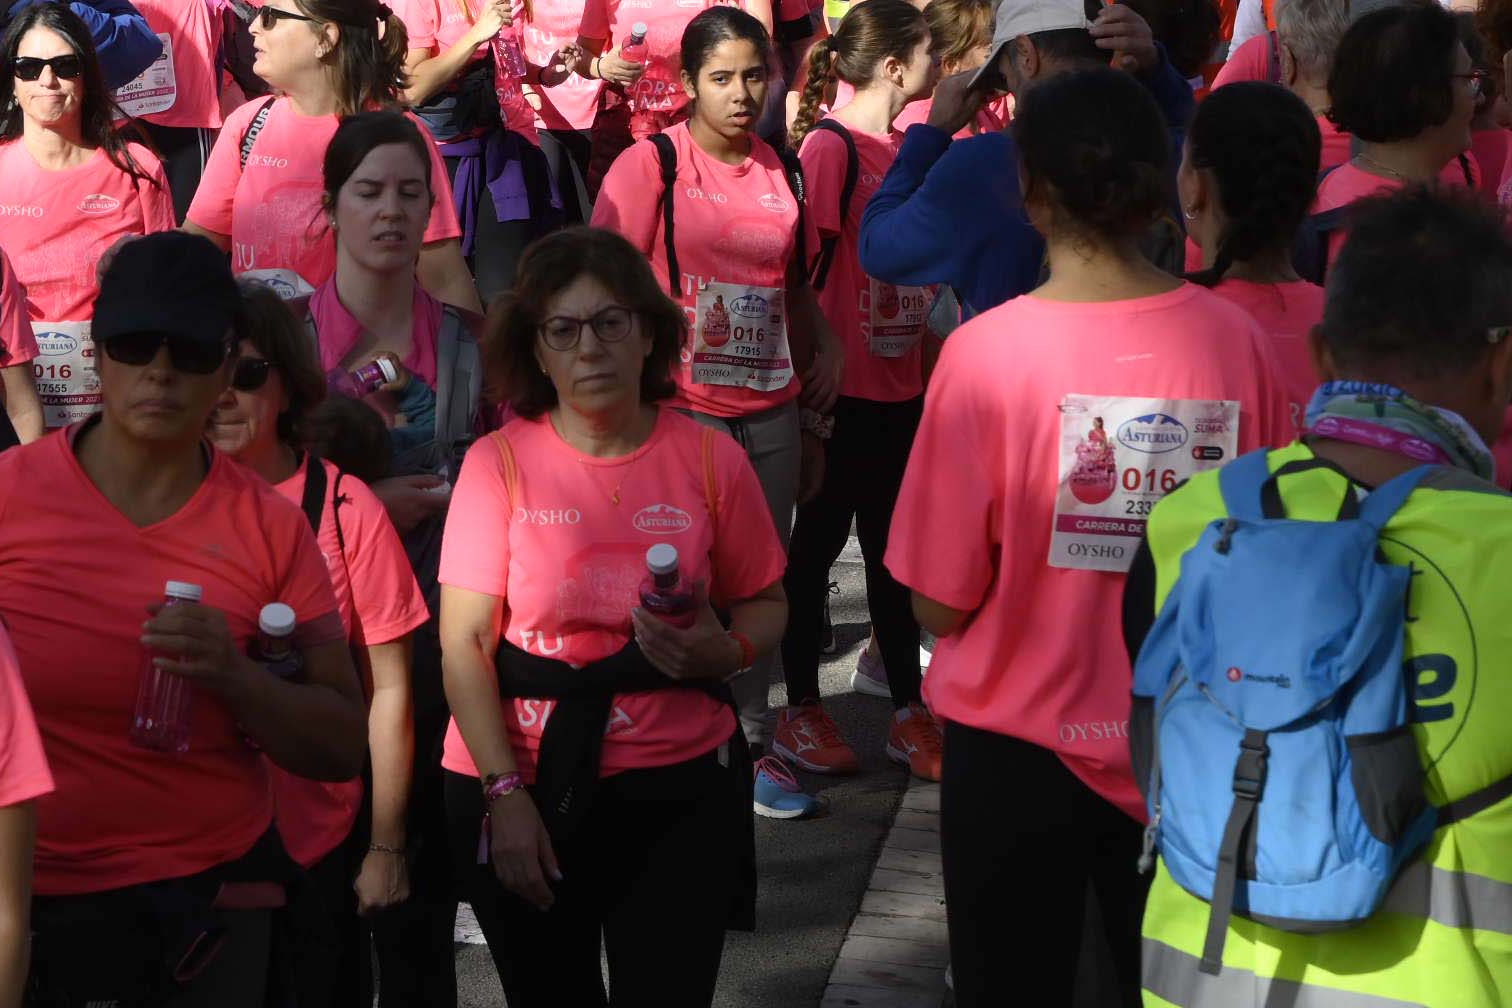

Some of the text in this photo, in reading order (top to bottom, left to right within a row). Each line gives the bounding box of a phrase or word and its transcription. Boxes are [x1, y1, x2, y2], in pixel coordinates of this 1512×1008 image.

[733, 326, 765, 342] 016
[735, 346, 761, 356] 17915
[34, 364, 72, 379] 016
[1123, 427, 1183, 443] ASTURIANA
[1122, 467, 1177, 492] 016
[1125, 500, 1156, 515] 233
[1076, 521, 1126, 532] CARRERA
[1067, 543, 1125, 559] OYSHO
[519, 630, 563, 656] TU
[1058, 720, 1128, 744] OYSH
